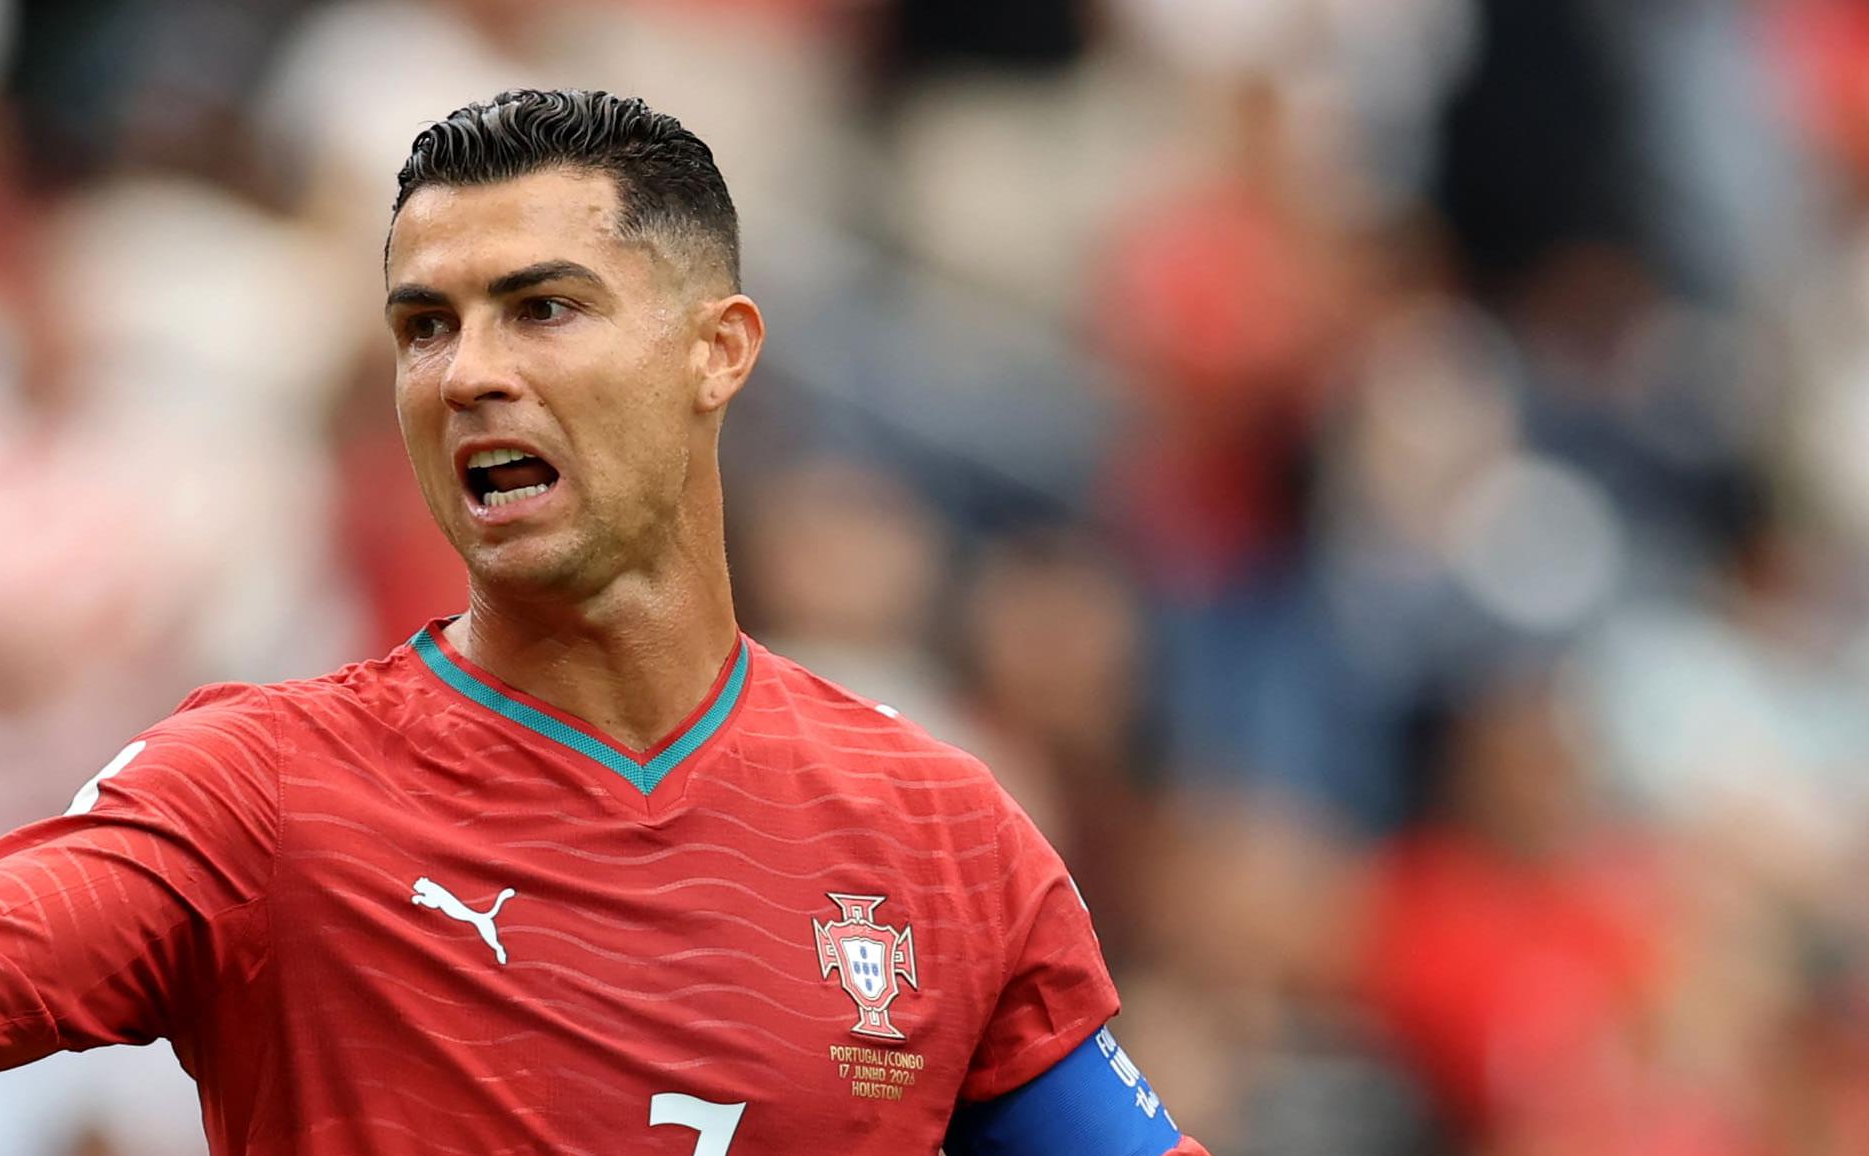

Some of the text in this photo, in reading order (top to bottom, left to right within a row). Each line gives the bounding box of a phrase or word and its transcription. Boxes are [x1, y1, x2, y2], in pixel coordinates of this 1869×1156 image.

[830, 1046, 924, 1069] PORTUGAL/CONGO
[839, 1064, 915, 1085] 17 JUNHO 2026
[852, 1082, 903, 1101] HOUSTON
